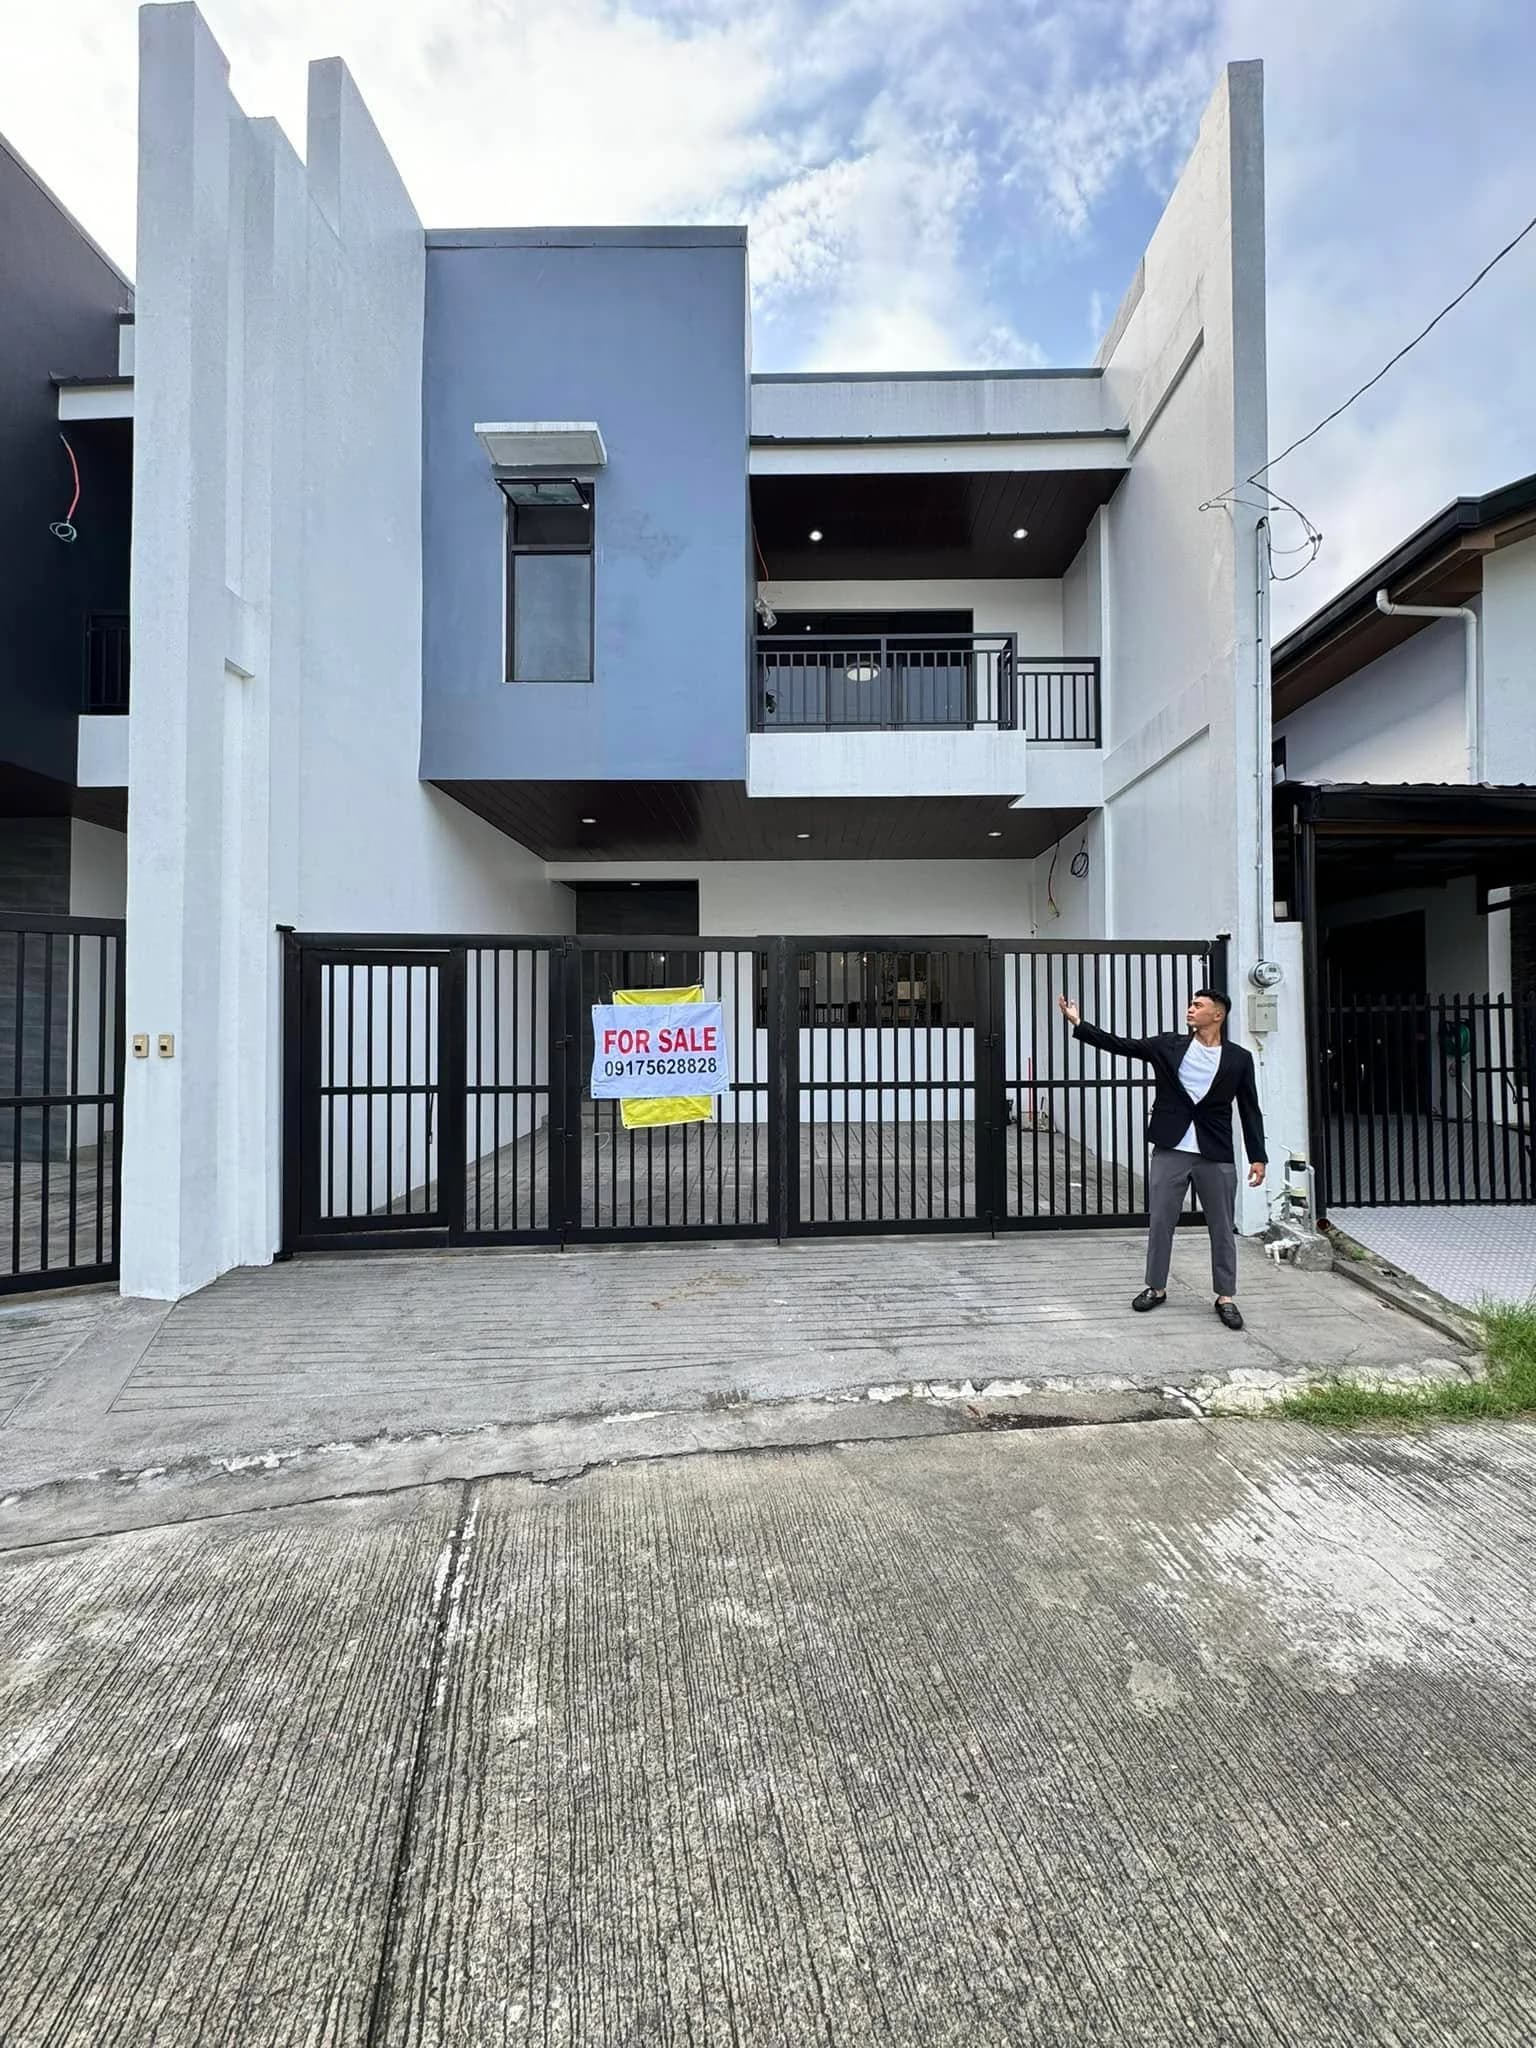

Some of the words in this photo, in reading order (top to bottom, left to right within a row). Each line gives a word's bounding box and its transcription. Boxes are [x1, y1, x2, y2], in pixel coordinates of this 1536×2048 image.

[604, 1028, 650, 1055] FOR
[658, 1026, 717, 1054] SALE
[604, 1057, 717, 1077] 09175628828
